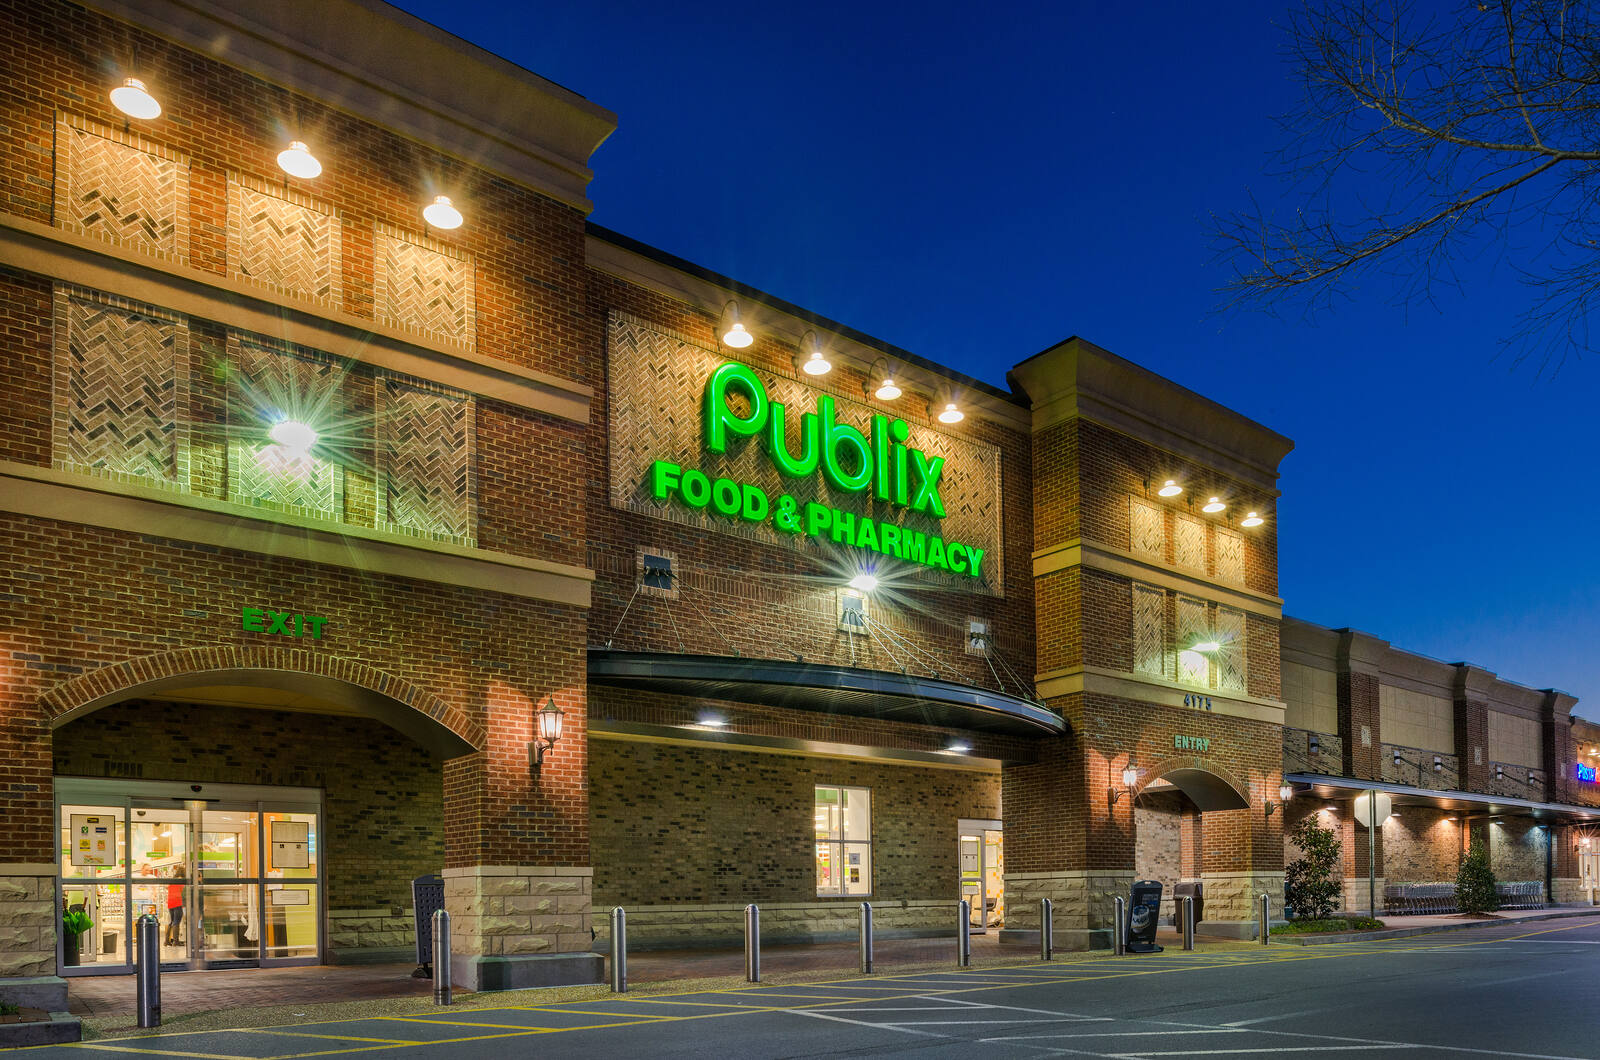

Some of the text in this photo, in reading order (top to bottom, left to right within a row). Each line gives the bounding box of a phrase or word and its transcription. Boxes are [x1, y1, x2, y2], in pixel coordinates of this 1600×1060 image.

[704, 361, 946, 519] Publix
[651, 460, 984, 578] FOOD & PHARMACY
[242, 606, 328, 640] EXIT
[1184, 694, 1212, 710] 4175
[1174, 735, 1210, 751] ENTRY
